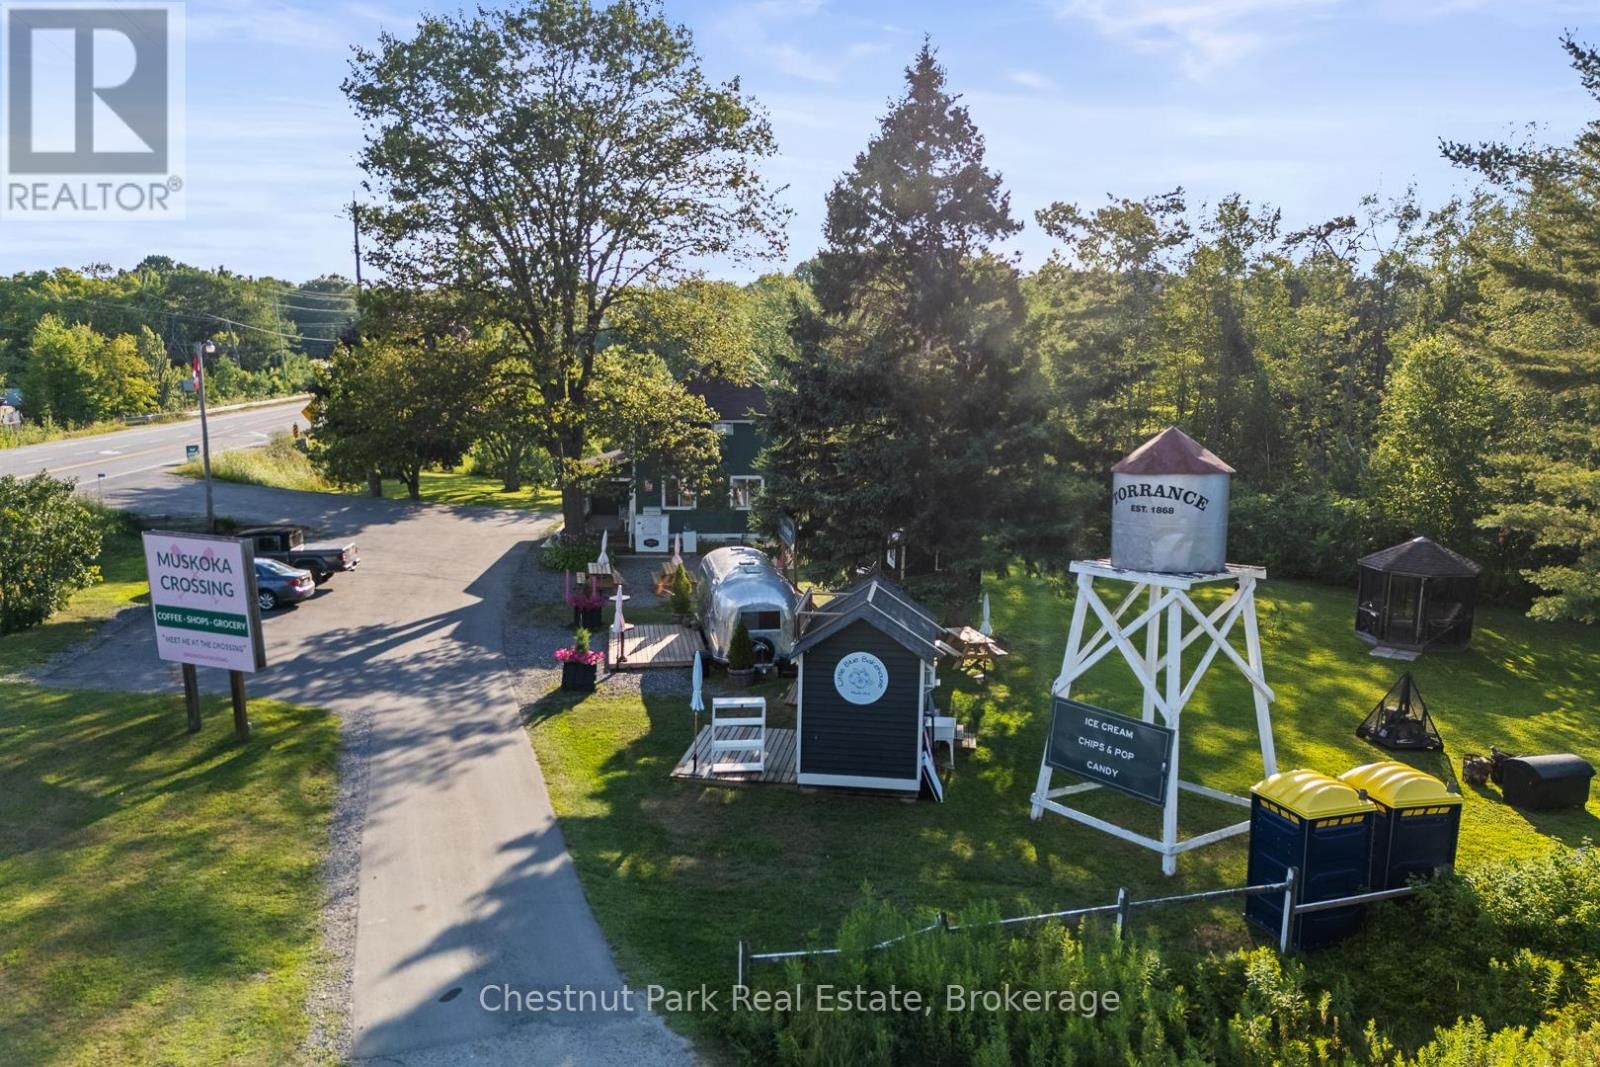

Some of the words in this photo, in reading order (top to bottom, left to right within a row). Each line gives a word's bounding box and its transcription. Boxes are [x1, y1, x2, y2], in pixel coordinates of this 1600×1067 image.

[1113, 483, 1209, 511] TORRANCE
[1130, 504, 1148, 513] EST.
[1151, 506, 1175, 515] 1868
[156, 551, 232, 574] MUSKOKA
[160, 575, 234, 597] CROSSING
[157, 611, 183, 622] COFFEE
[186, 615, 210, 625] SHOPS
[213, 618, 247, 631] GROCERY
[182, 637, 191, 645] ME
[191, 638, 200, 646] AT
[200, 639, 211, 648] THE
[1084, 717, 1099, 729] ICE
[1101, 722, 1134, 739] CREAM
[1078, 736, 1105, 752] CHIPS
[1106, 745, 1113, 755] &
[1114, 748, 1135, 761] POP
[1086, 760, 1119, 778] CANDY
